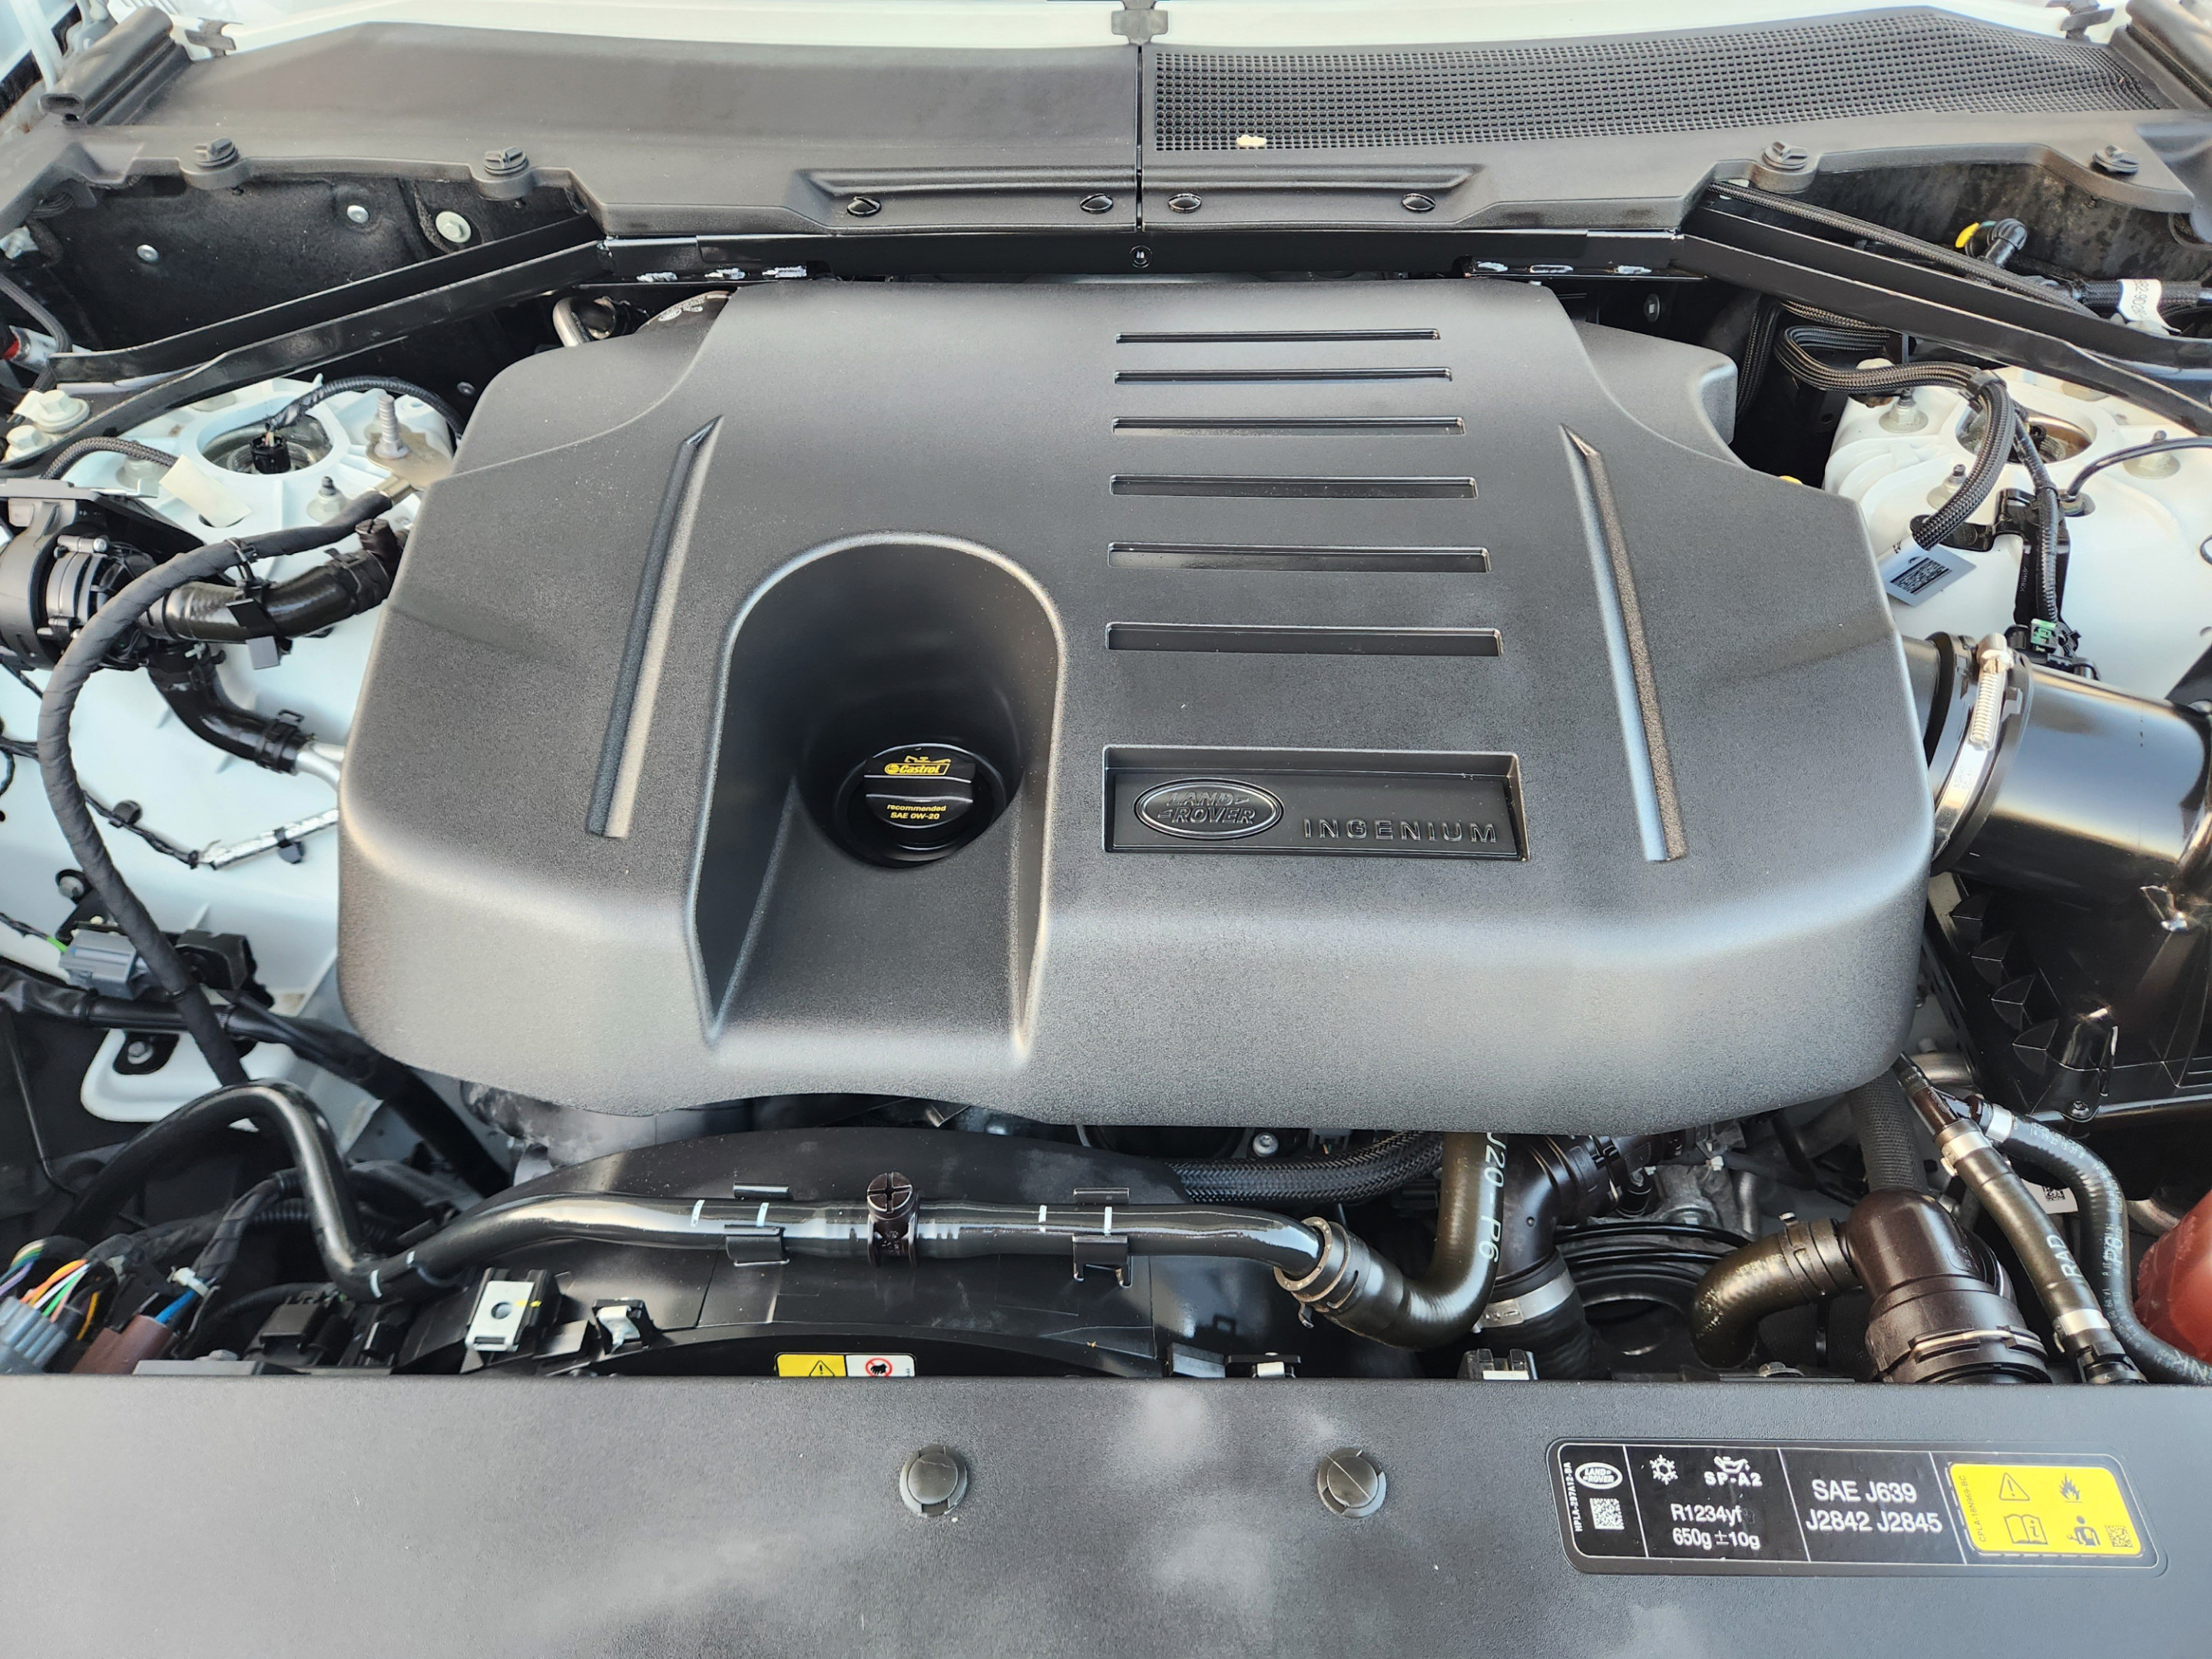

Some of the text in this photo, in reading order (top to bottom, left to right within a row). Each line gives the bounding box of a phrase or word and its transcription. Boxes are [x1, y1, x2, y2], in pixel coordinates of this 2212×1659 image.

[899, 764, 941, 773] Castrol
[1167, 792, 1234, 806] LAND
[1171, 806, 1256, 824] ROVER
[1303, 818, 1497, 843] INGENIUM
[1478, 1215, 1502, 1263] P6
[2046, 1235, 2083, 1277] RAD
[1584, 1467, 1607, 1475] LAND
[1588, 1475, 1614, 1483] ROVER
[1704, 1471, 1763, 1487] SP-A2
[1811, 1479, 1918, 1503] SAE J639
[1670, 1503, 1742, 1527] R1234yf
[1806, 1508, 1943, 1533] J2842 J2845
[1672, 1527, 1713, 1551] 650g
